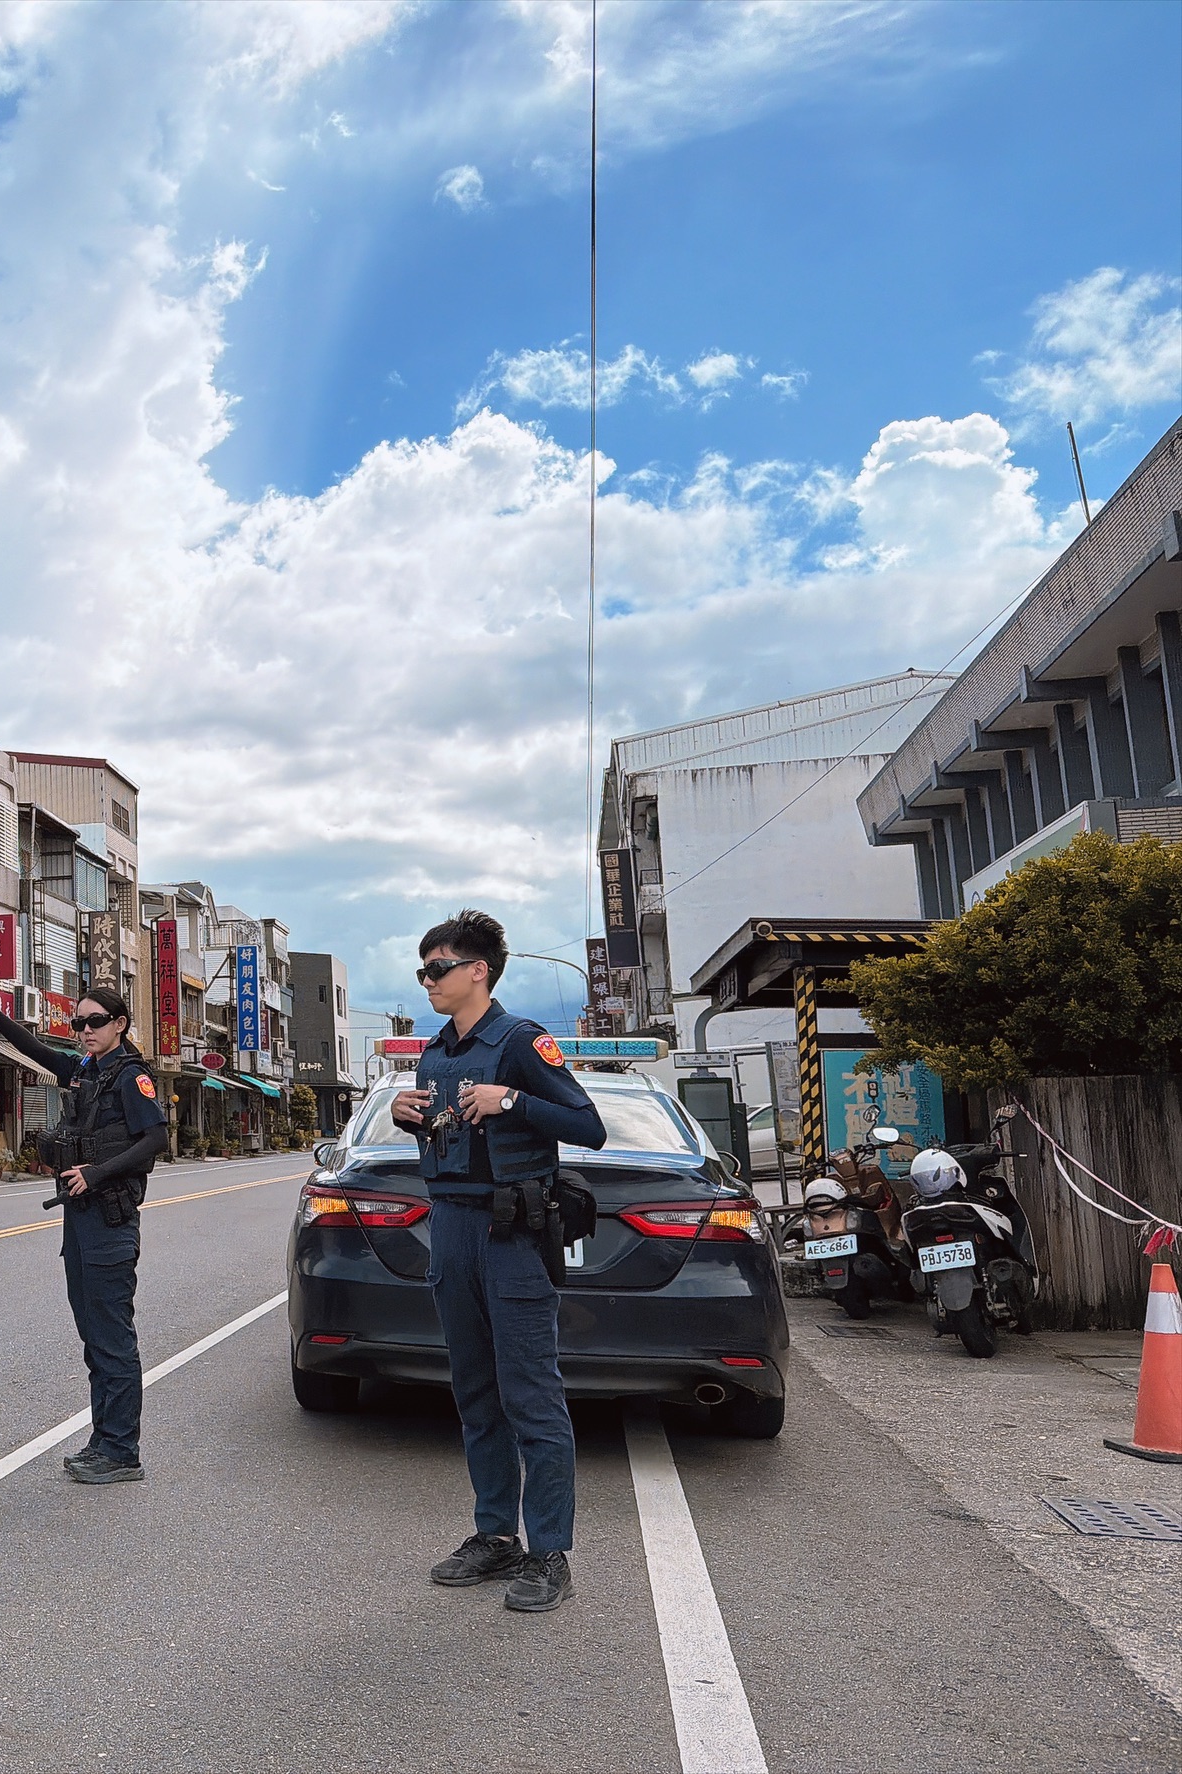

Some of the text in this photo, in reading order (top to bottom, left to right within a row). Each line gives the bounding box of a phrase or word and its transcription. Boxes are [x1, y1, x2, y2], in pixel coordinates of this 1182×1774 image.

[93, 913, 117, 990] 時代皮
[590, 946, 611, 1036] 建興碾米工
[240, 948, 255, 1048] 好朋友肉包店
